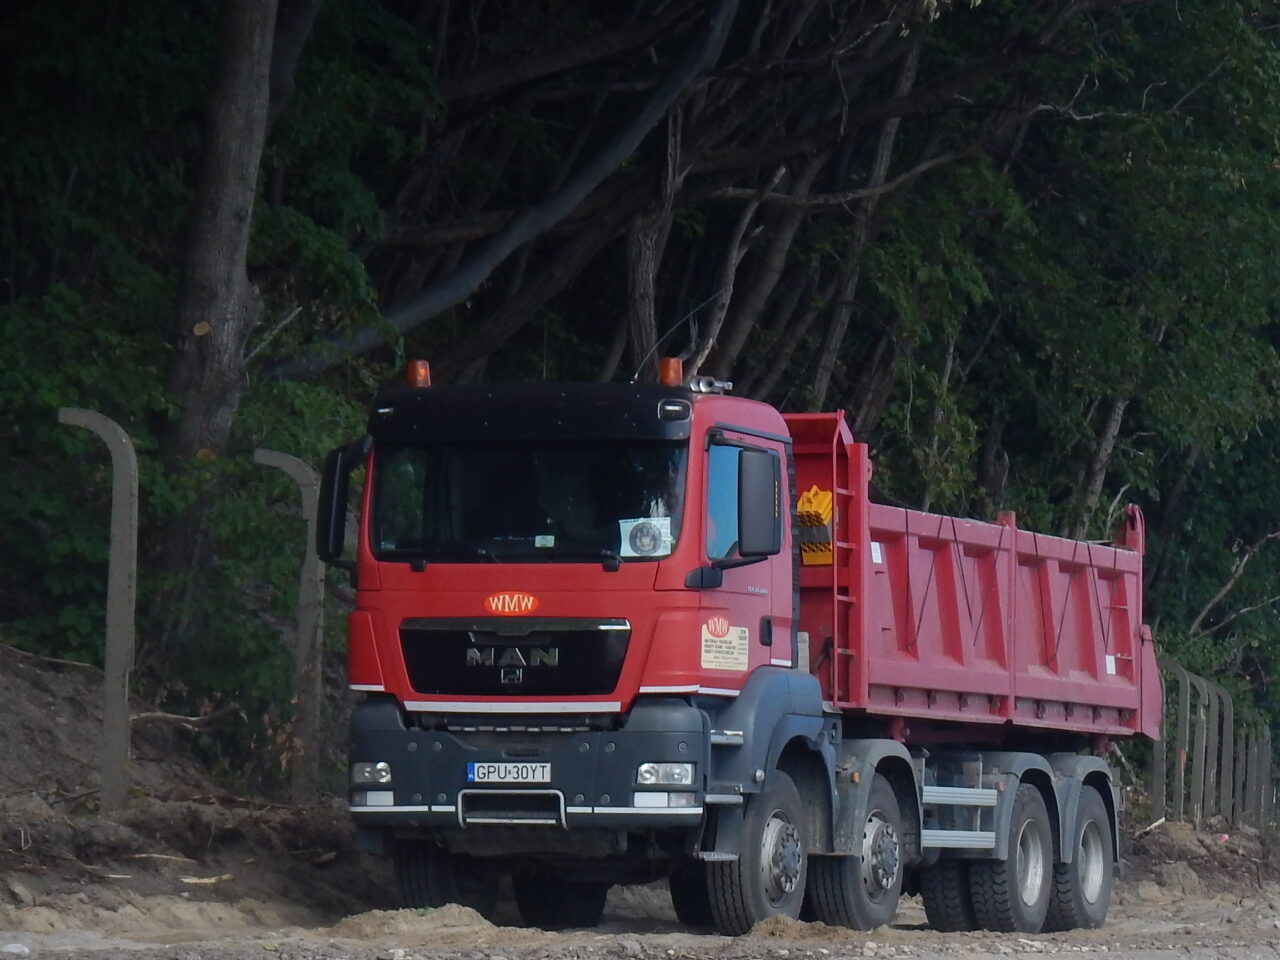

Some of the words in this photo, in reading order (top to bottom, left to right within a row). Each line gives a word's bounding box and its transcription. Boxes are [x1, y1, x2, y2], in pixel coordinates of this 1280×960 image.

[489, 594, 534, 612] WMW
[466, 647, 559, 666] MAN
[477, 765, 507, 780] GPU
[512, 765, 548, 780] 30YT
